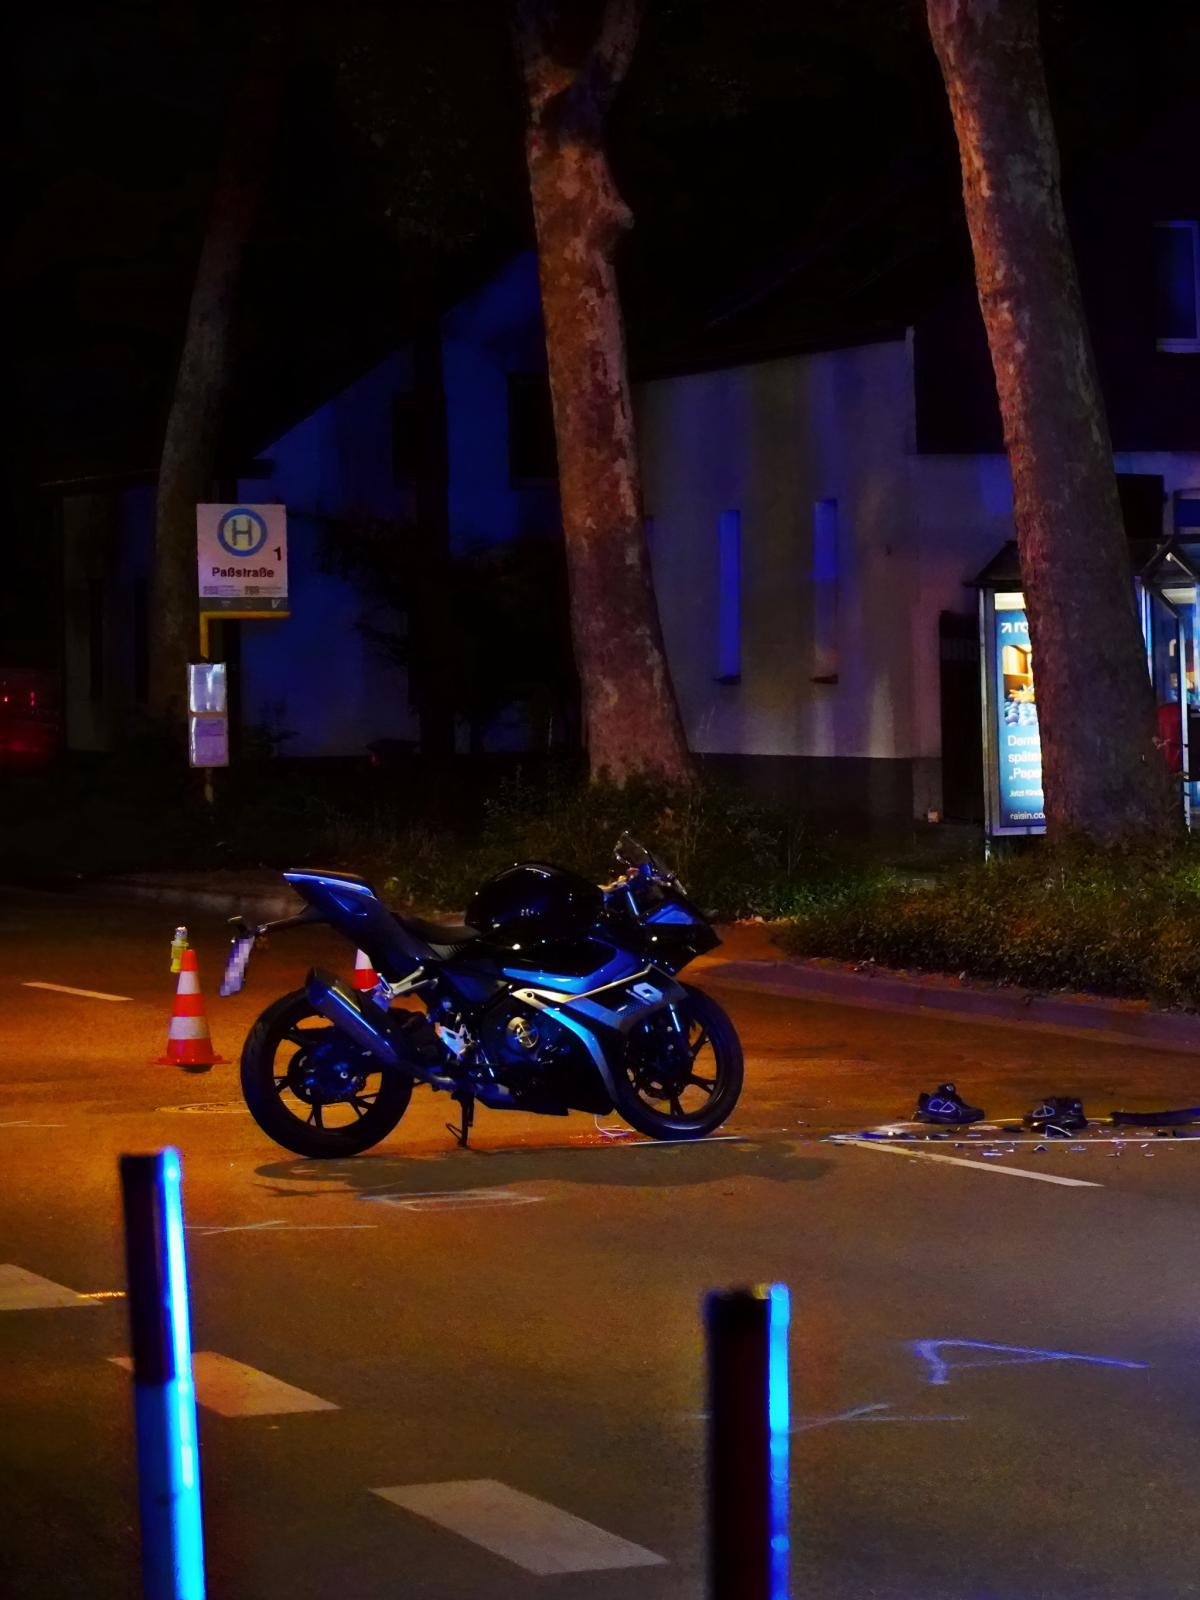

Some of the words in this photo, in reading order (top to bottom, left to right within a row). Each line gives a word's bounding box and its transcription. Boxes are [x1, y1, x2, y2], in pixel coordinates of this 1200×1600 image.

[232, 518, 252, 546] H
[273, 546, 281, 561] 1
[211, 566, 275, 578] Paßstraße
[1010, 811, 1046, 820] raisin.co
